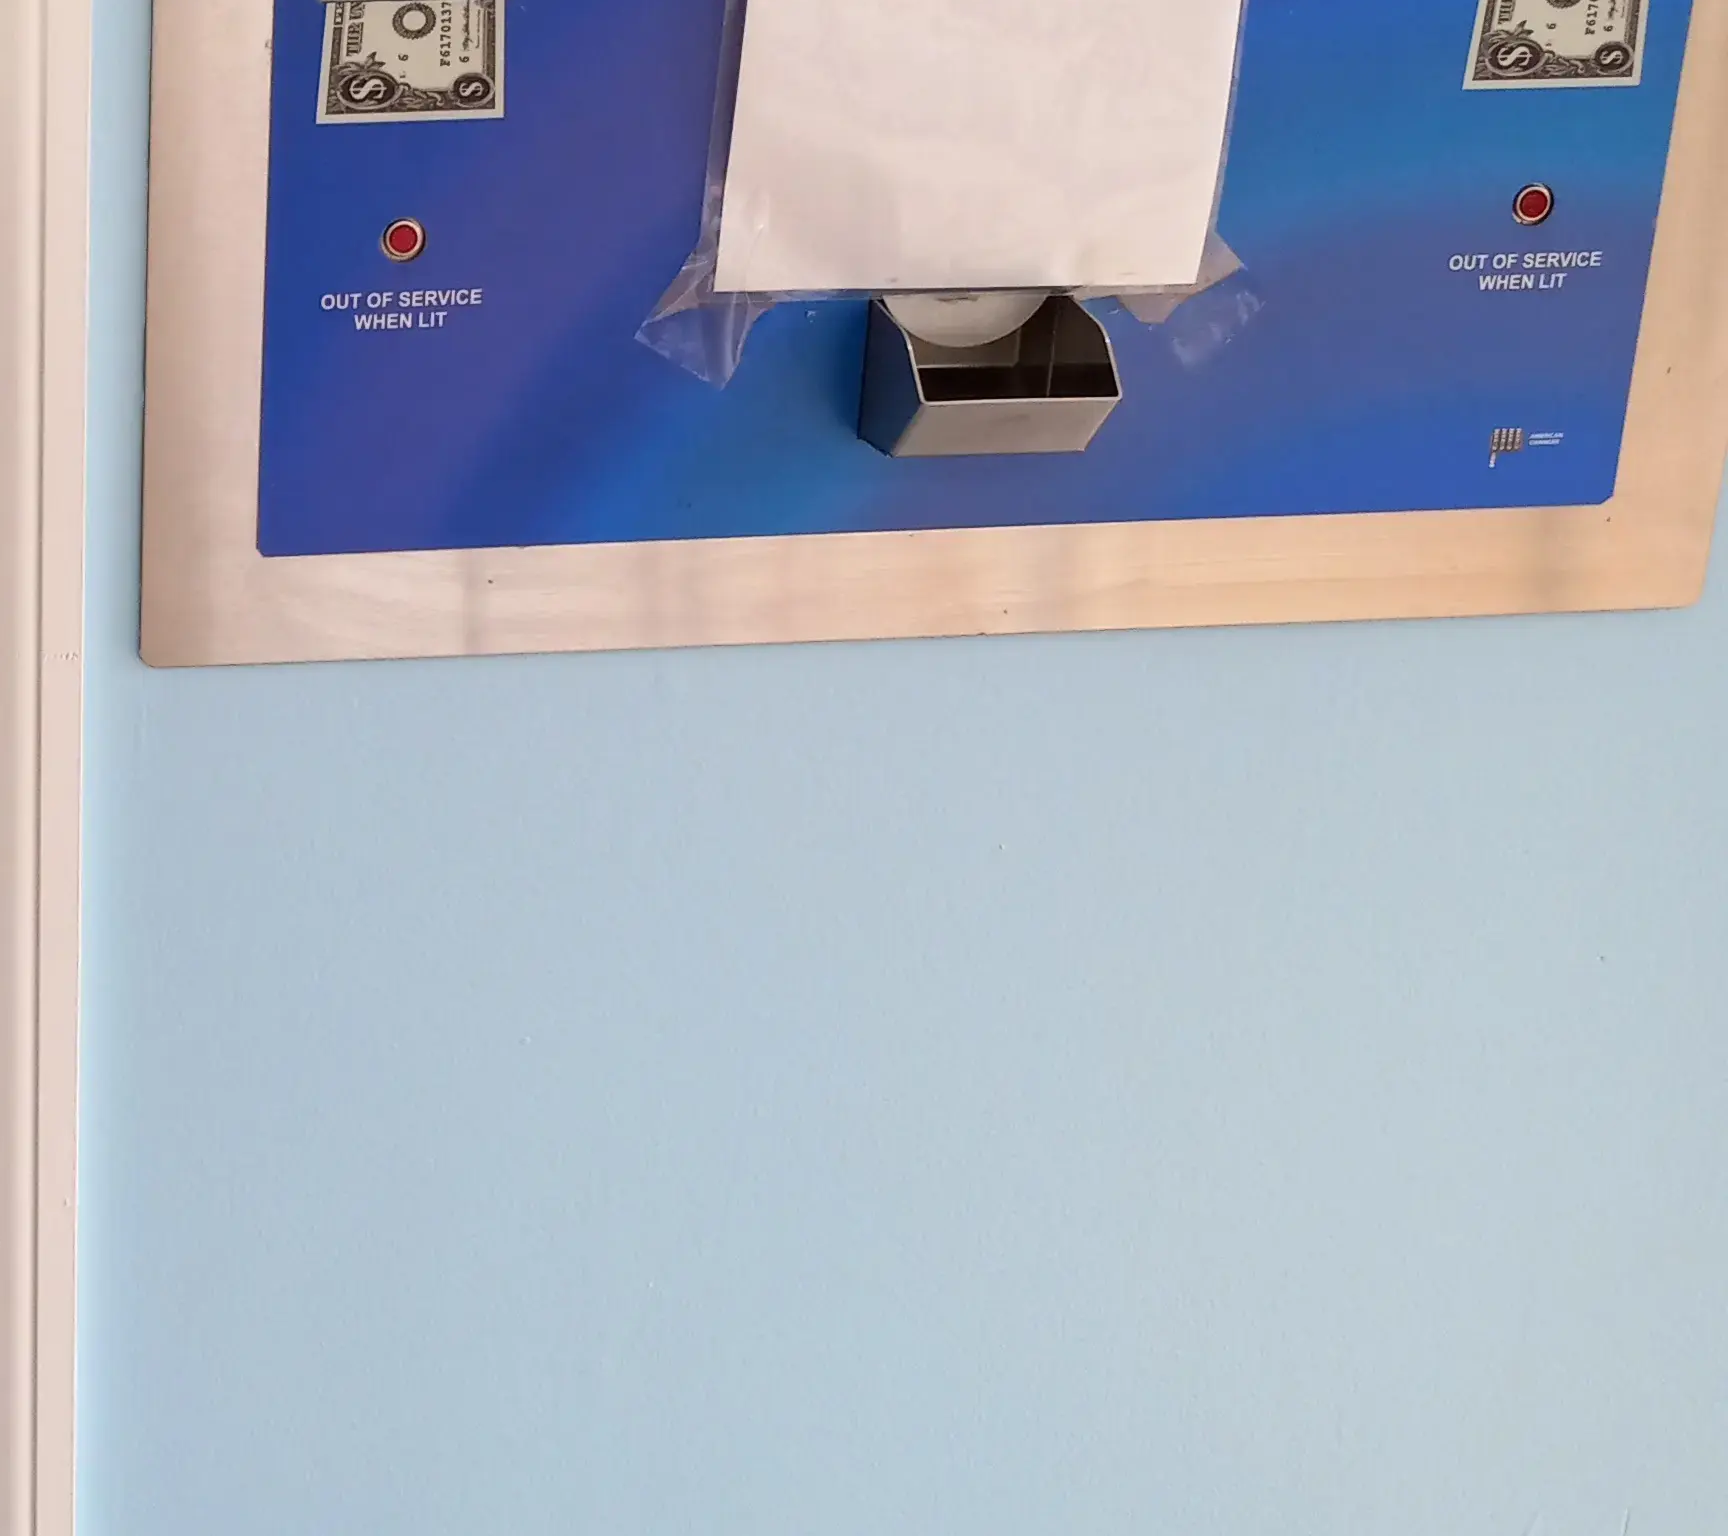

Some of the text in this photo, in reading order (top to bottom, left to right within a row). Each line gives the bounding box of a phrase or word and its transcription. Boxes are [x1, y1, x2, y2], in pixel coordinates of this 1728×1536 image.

[1449, 251, 1603, 271] OUT OF SERVICE
[1479, 273, 1568, 291] WHEN LIT
[321, 288, 483, 310] OUT OF SERVICE
[354, 311, 448, 331] WHEN LIT
